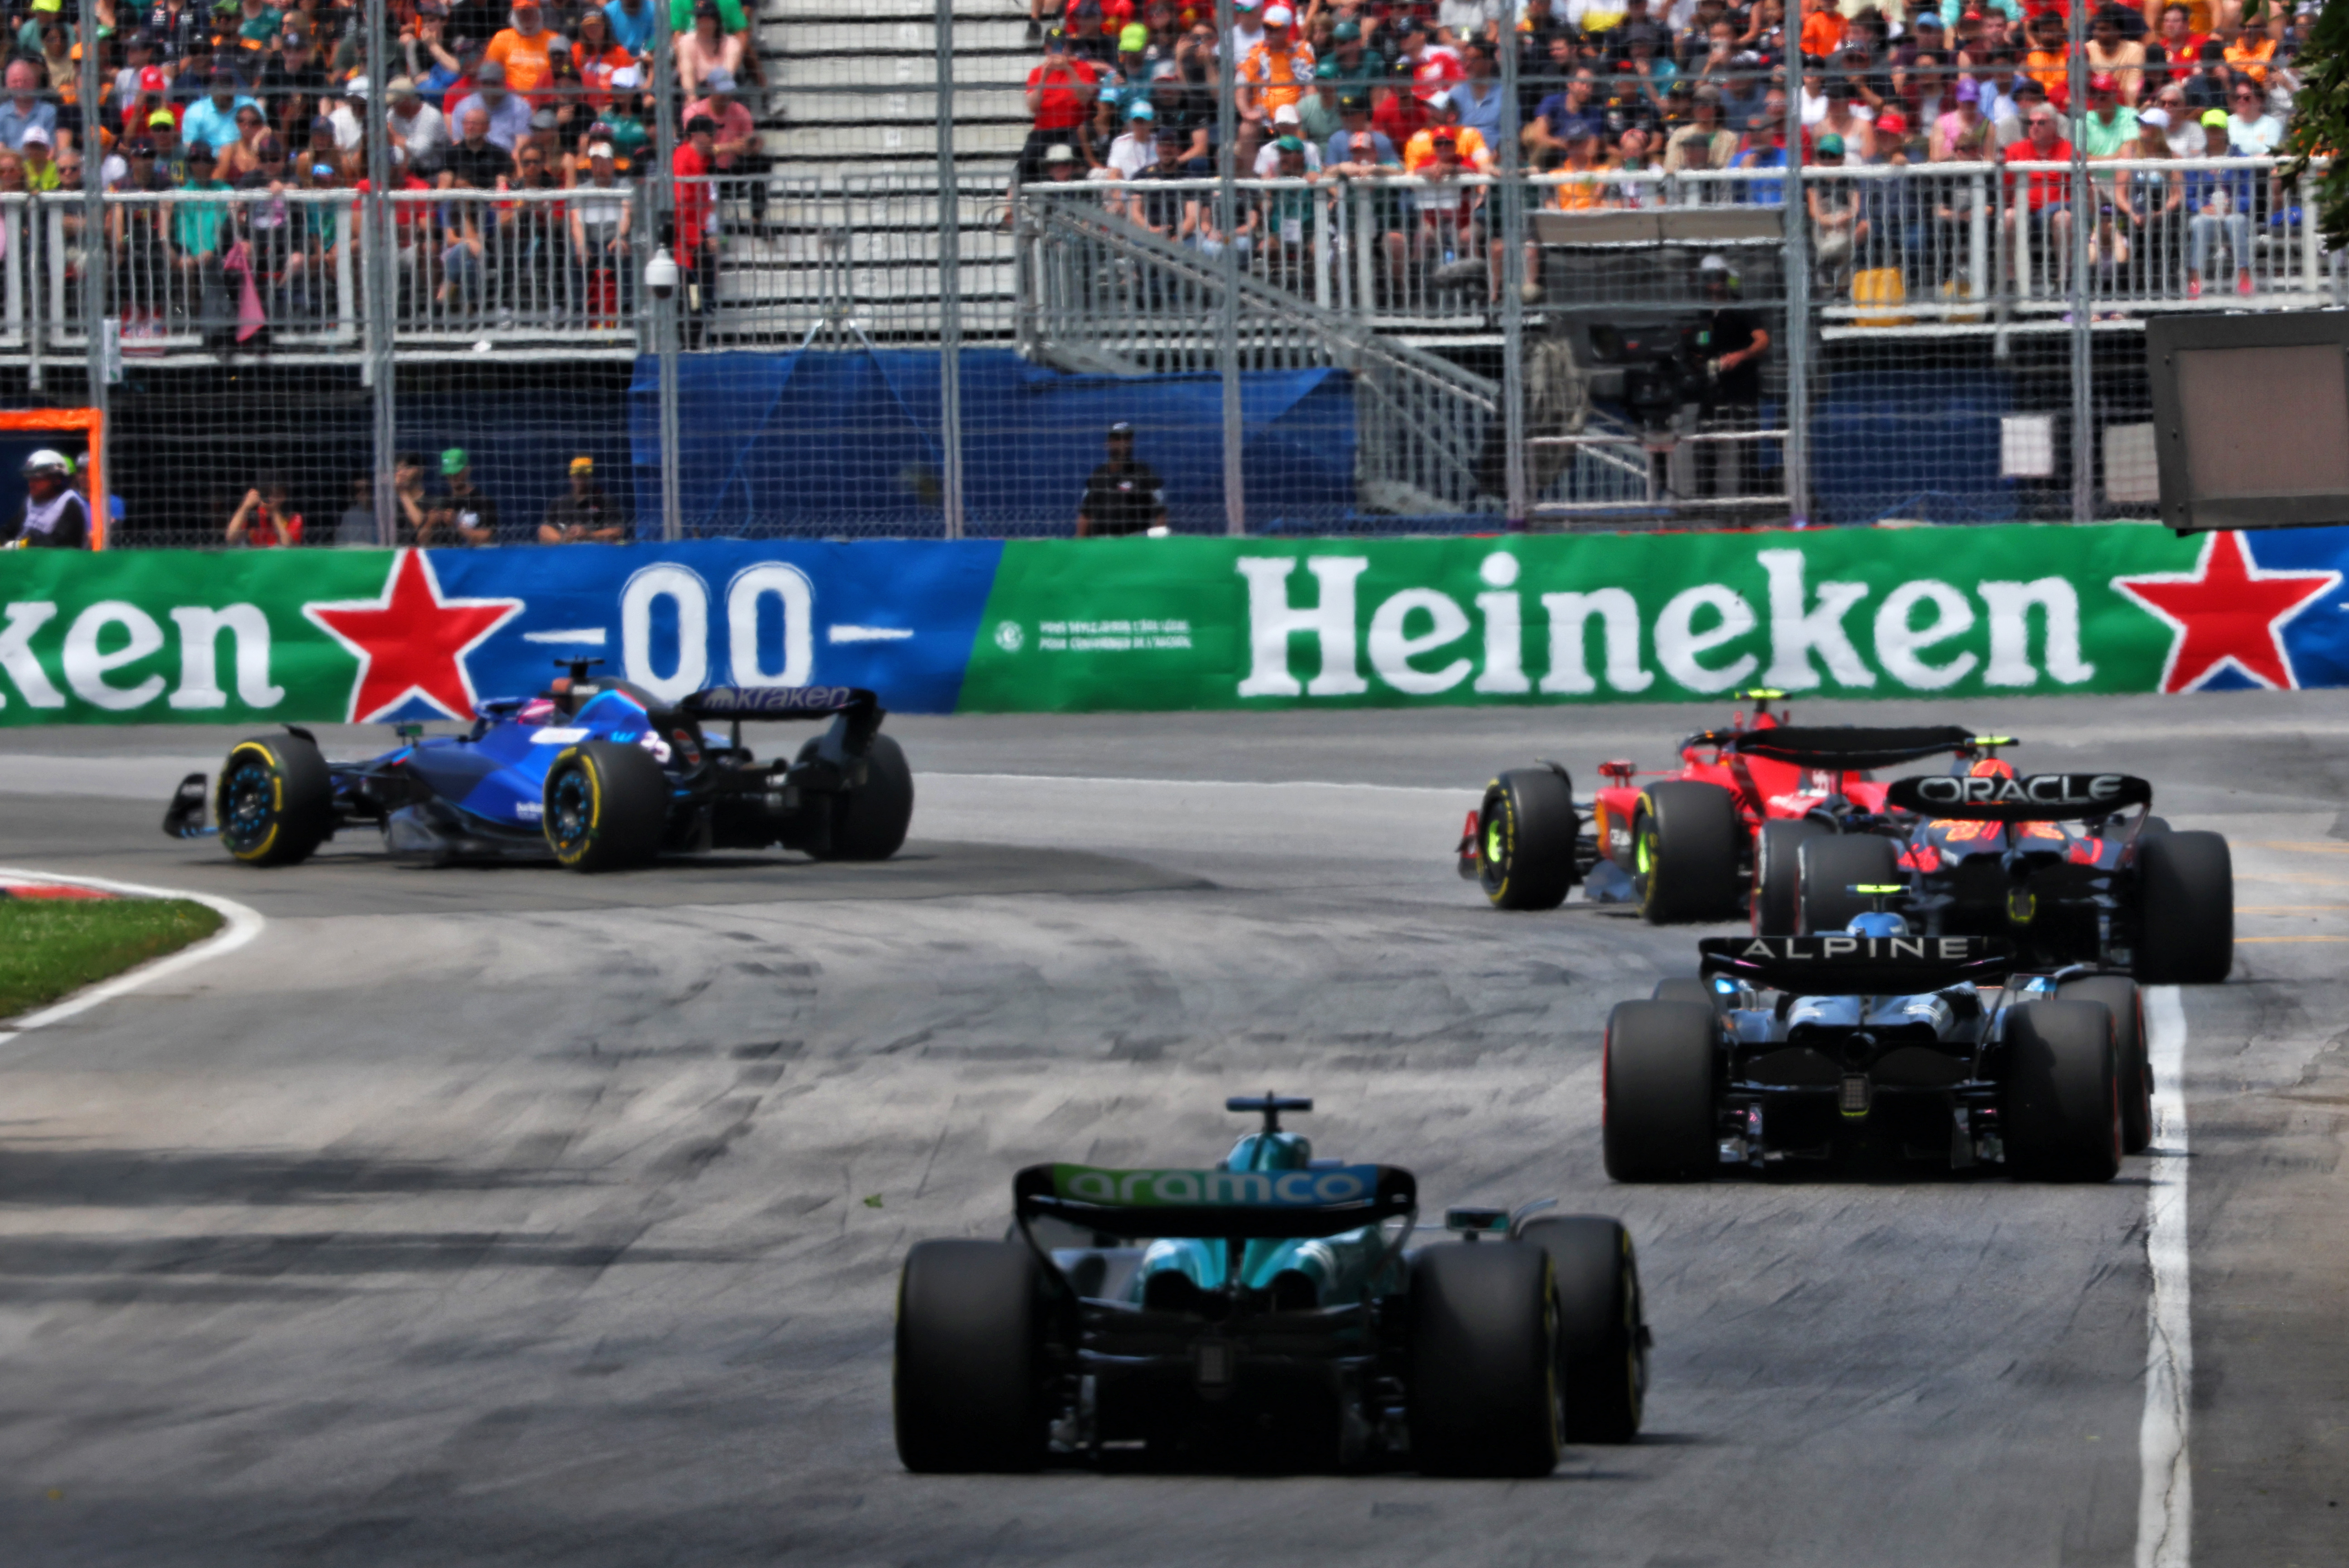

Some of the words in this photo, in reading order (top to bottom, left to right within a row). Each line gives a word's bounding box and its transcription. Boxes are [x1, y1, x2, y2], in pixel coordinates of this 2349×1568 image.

[1236, 548, 2094, 696] Heineken
[737, 686, 850, 708] kraken
[1917, 775, 2123, 804] ORACLE
[1741, 937, 1968, 959] ALPINE
[1068, 1171, 1363, 1201] aramco
